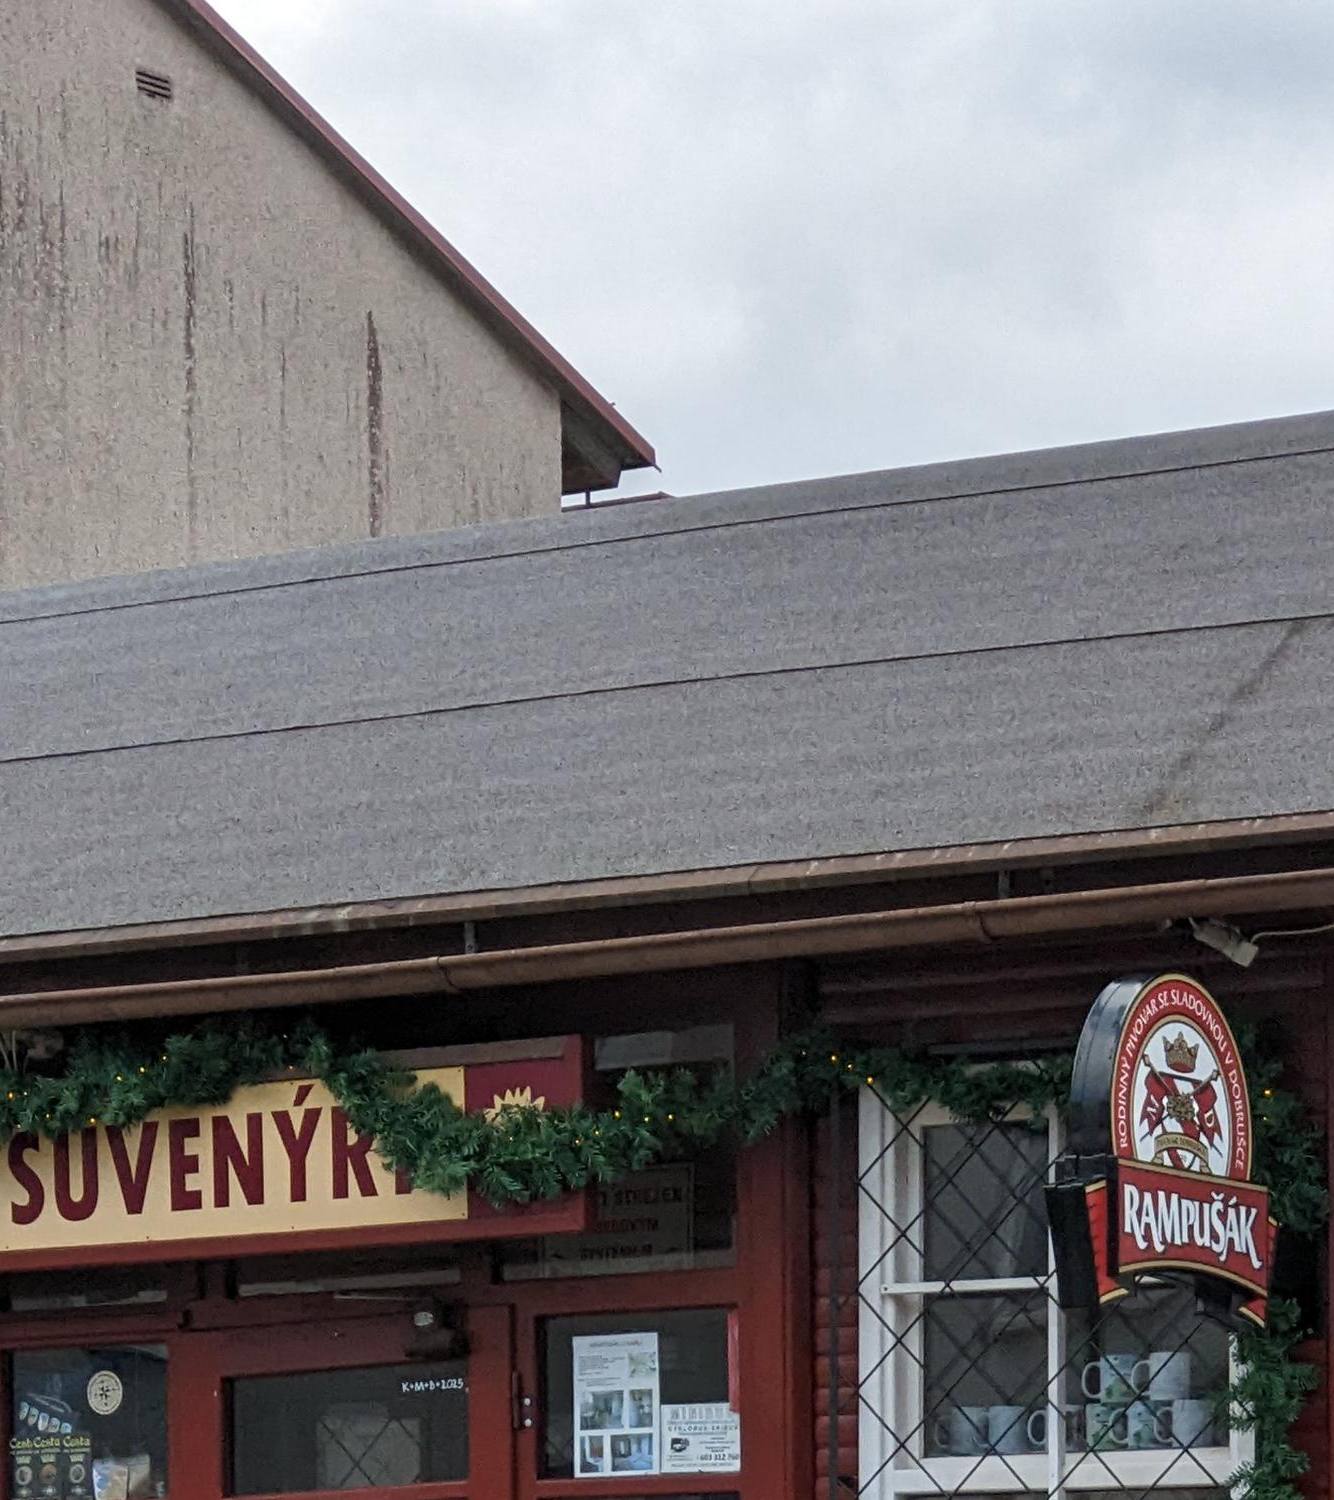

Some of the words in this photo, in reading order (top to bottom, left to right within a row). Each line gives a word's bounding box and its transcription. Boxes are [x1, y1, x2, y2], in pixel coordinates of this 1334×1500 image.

[1125, 1000, 1158, 1058] PIVOVAR
[1157, 991, 1169, 1008] SE
[1170, 989, 1227, 1052] SLADOVNOU
[1225, 1053, 1234, 1065] V
[7, 1084, 414, 1226] SUVENÝR
[1123, 1183, 1263, 1270] RAMPUŠÁK
